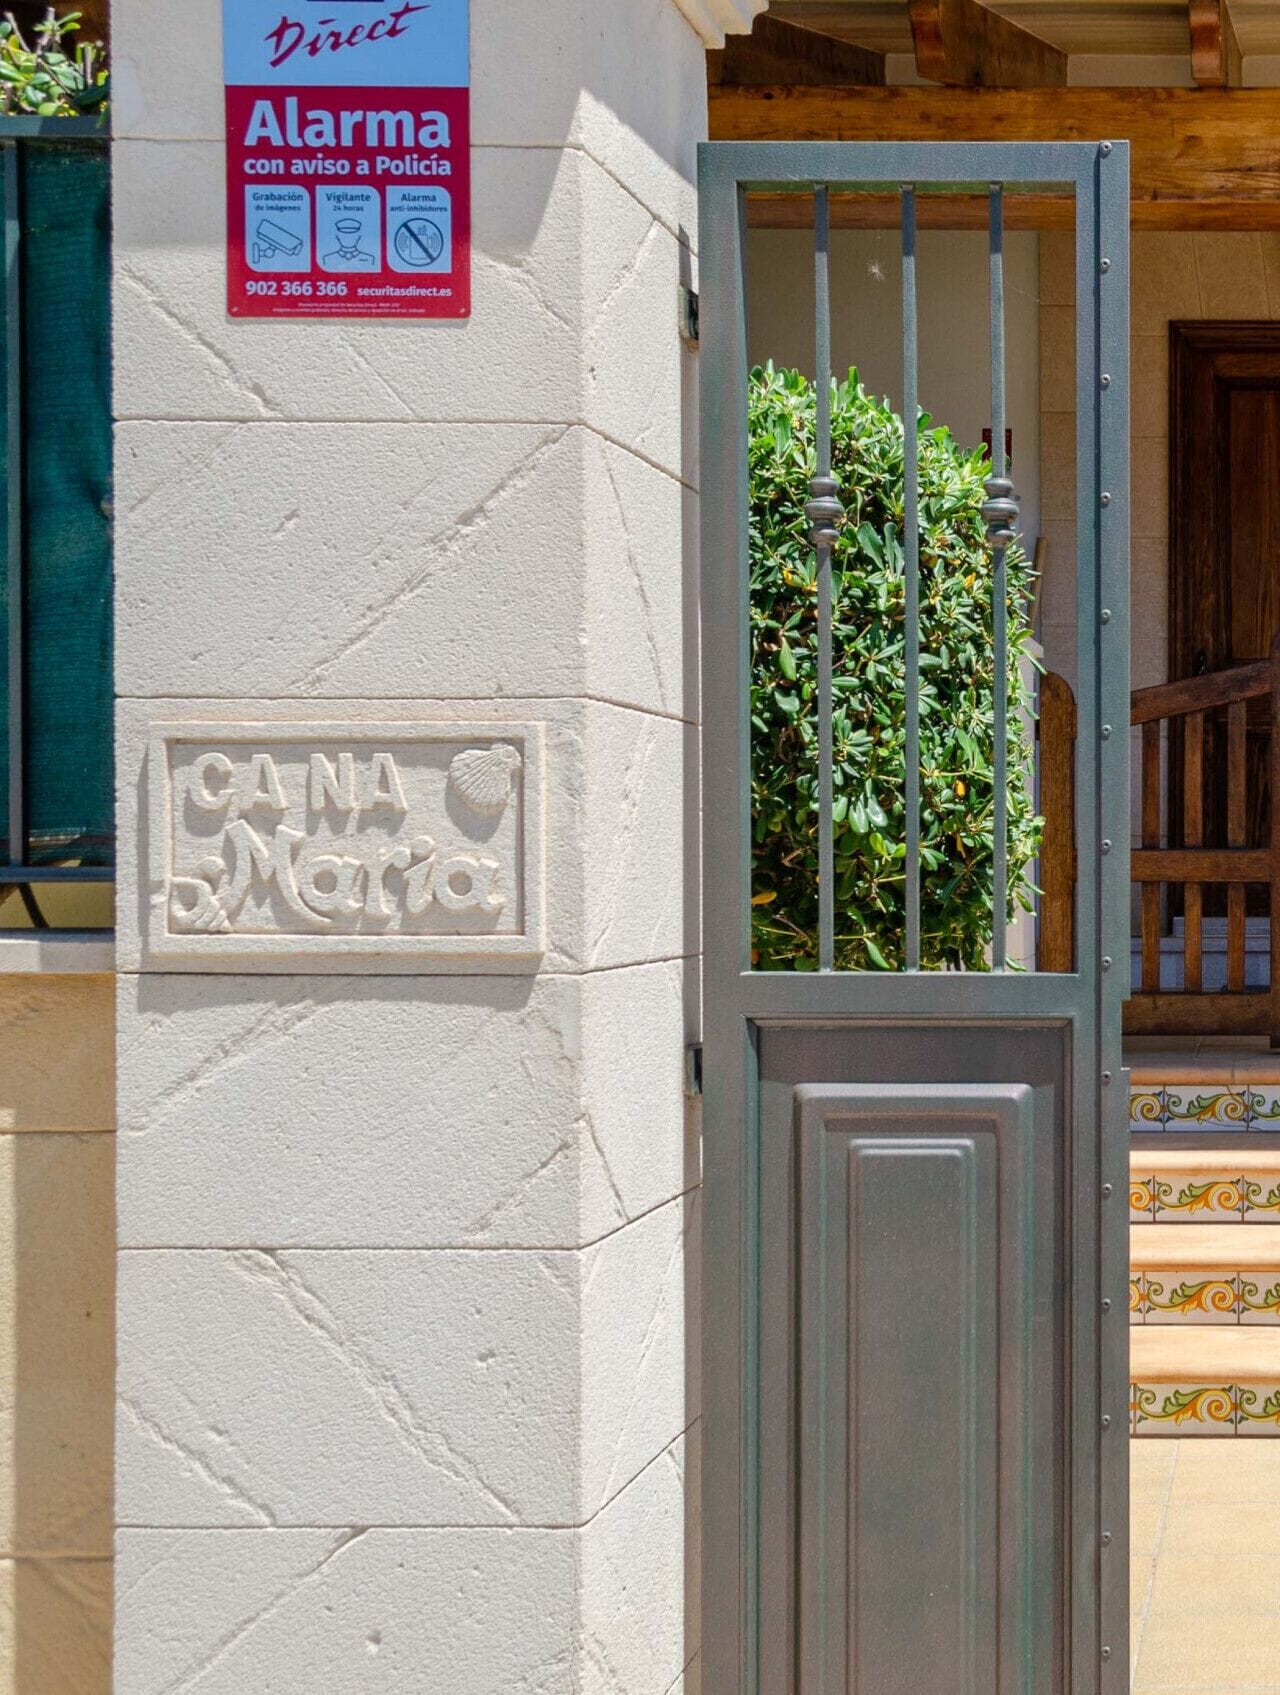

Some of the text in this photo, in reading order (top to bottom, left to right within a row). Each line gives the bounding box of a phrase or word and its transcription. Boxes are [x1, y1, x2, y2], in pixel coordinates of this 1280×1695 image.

[264, 2, 431, 68] Direct
[243, 96, 451, 149] Alarma
[243, 153, 451, 176] con aviso a Policía
[252, 192, 304, 202] Grabación
[325, 192, 371, 203] Vigilante
[400, 193, 437, 203] Alarma
[254, 204, 265, 212] de
[343, 204, 364, 212] horas
[389, 204, 448, 213] anti-inhibidores
[245, 281, 348, 296] 902 366 366
[357, 285, 452, 297] securitasdirect.es
